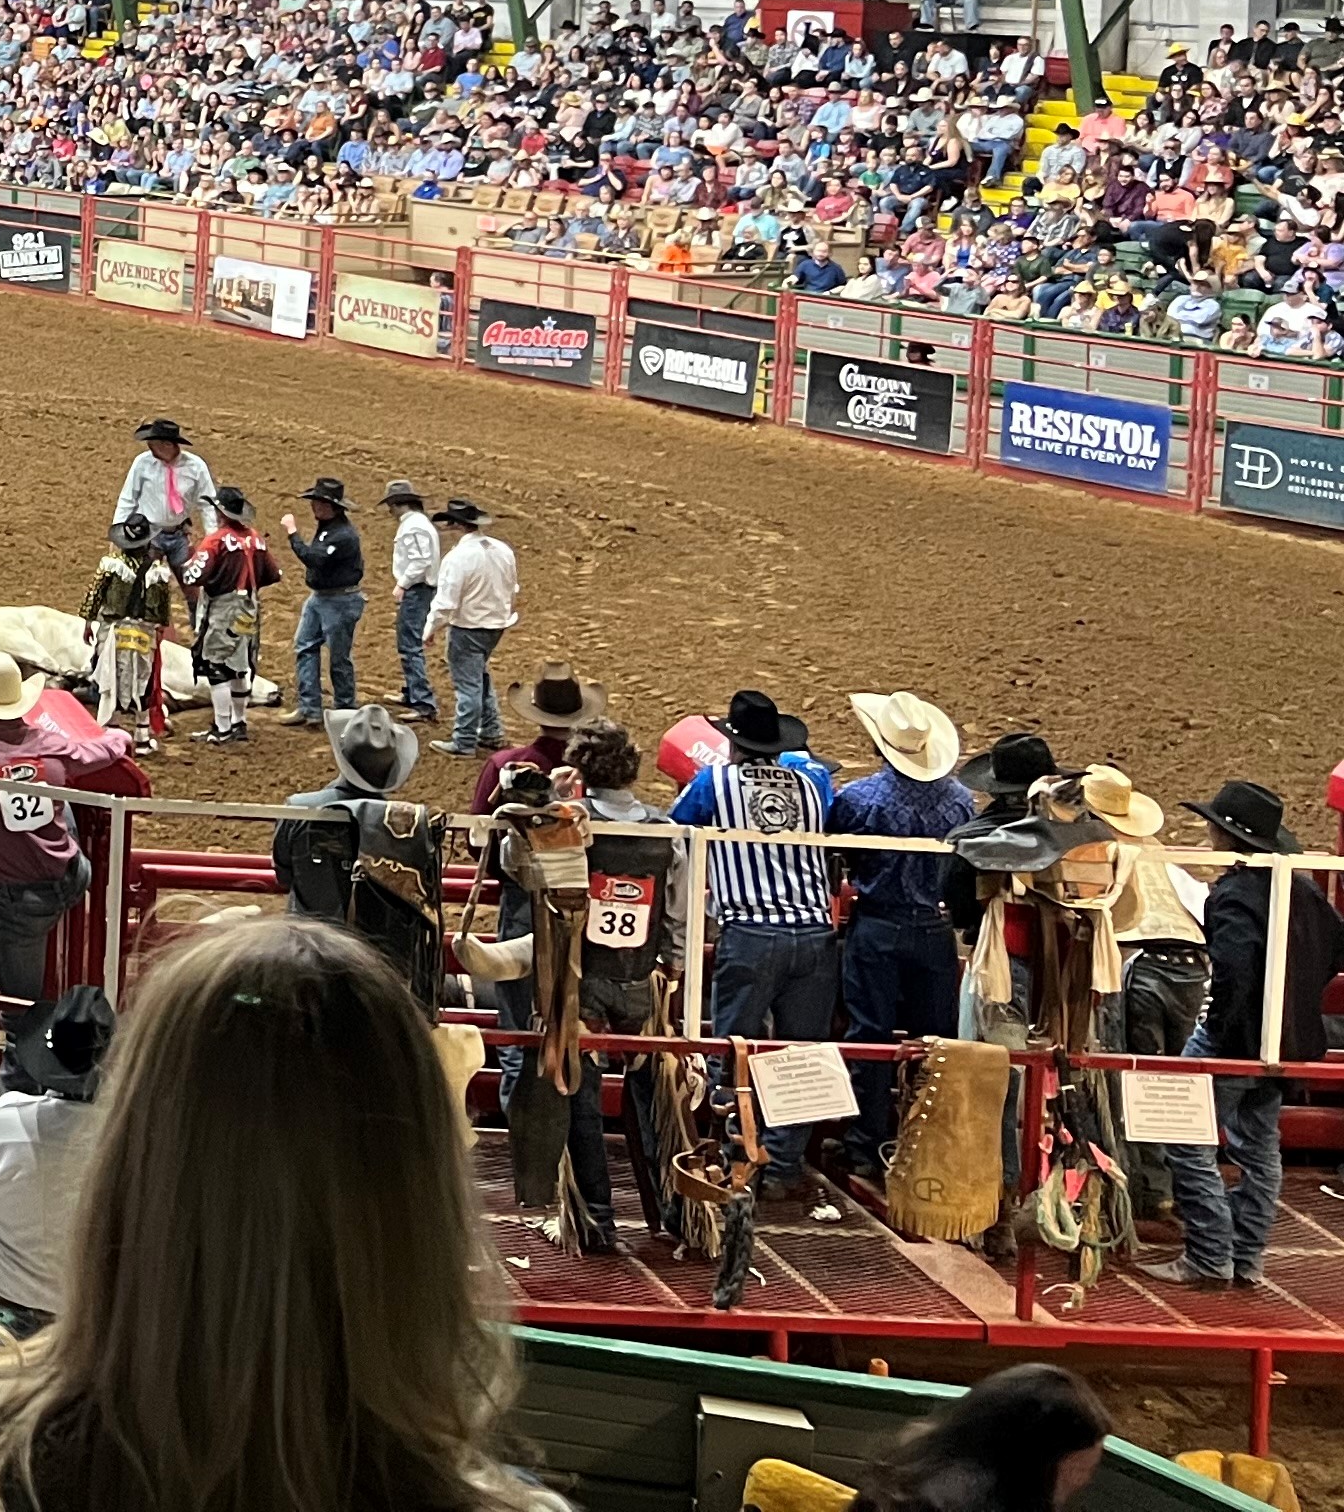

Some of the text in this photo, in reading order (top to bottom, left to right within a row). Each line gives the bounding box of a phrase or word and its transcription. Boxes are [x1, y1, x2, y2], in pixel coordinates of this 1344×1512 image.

[12, 231, 46, 250] 92.1
[100, 258, 181, 295] CAVENDER'S
[338, 294, 434, 338] CAVENDER'S
[483, 320, 589, 348] American
[839, 363, 914, 397] COWTOWN
[1009, 401, 1161, 458] RESISTOL
[1010, 435, 1157, 472] WE LIVE IT EVERY DAY
[1290, 458, 1334, 472] HOTEL
[742, 768, 795, 781] CINCH
[11, 795, 44, 821] 32
[599, 911, 636, 936] 38
